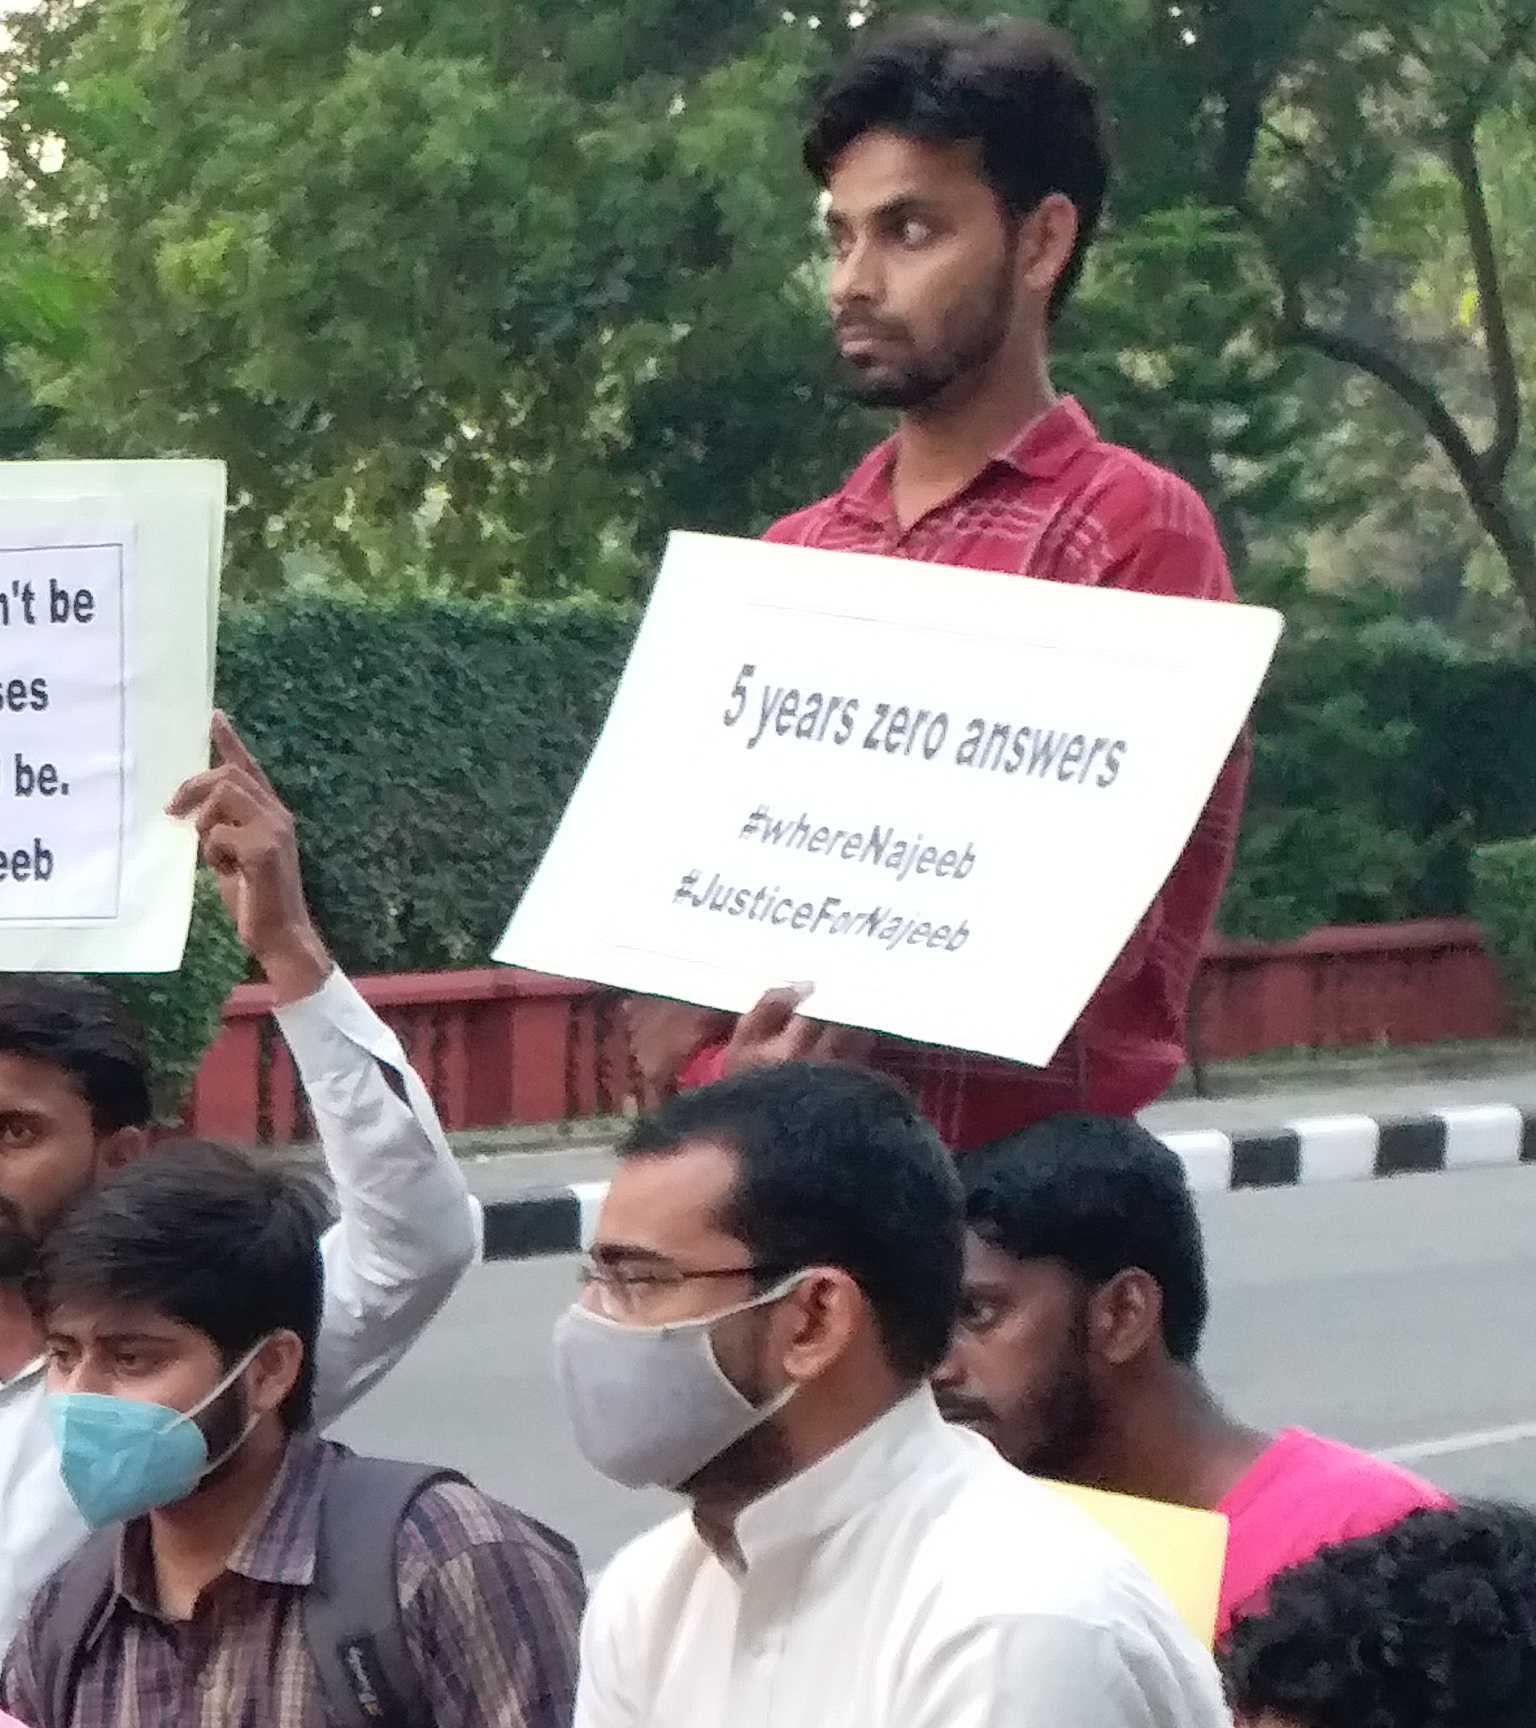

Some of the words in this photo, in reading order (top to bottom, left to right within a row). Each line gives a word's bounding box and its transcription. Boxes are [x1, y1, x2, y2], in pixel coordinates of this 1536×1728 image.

[49, 578, 95, 625] be
[723, 664, 756, 727] 5
[746, 679, 859, 750] years
[863, 702, 949, 761] zero
[956, 716, 1129, 788] answers
[15, 752, 69, 797] be.
[738, 803, 976, 881] #whereNajeeb
[673, 868, 970, 952] #JusticeForNajeeb
